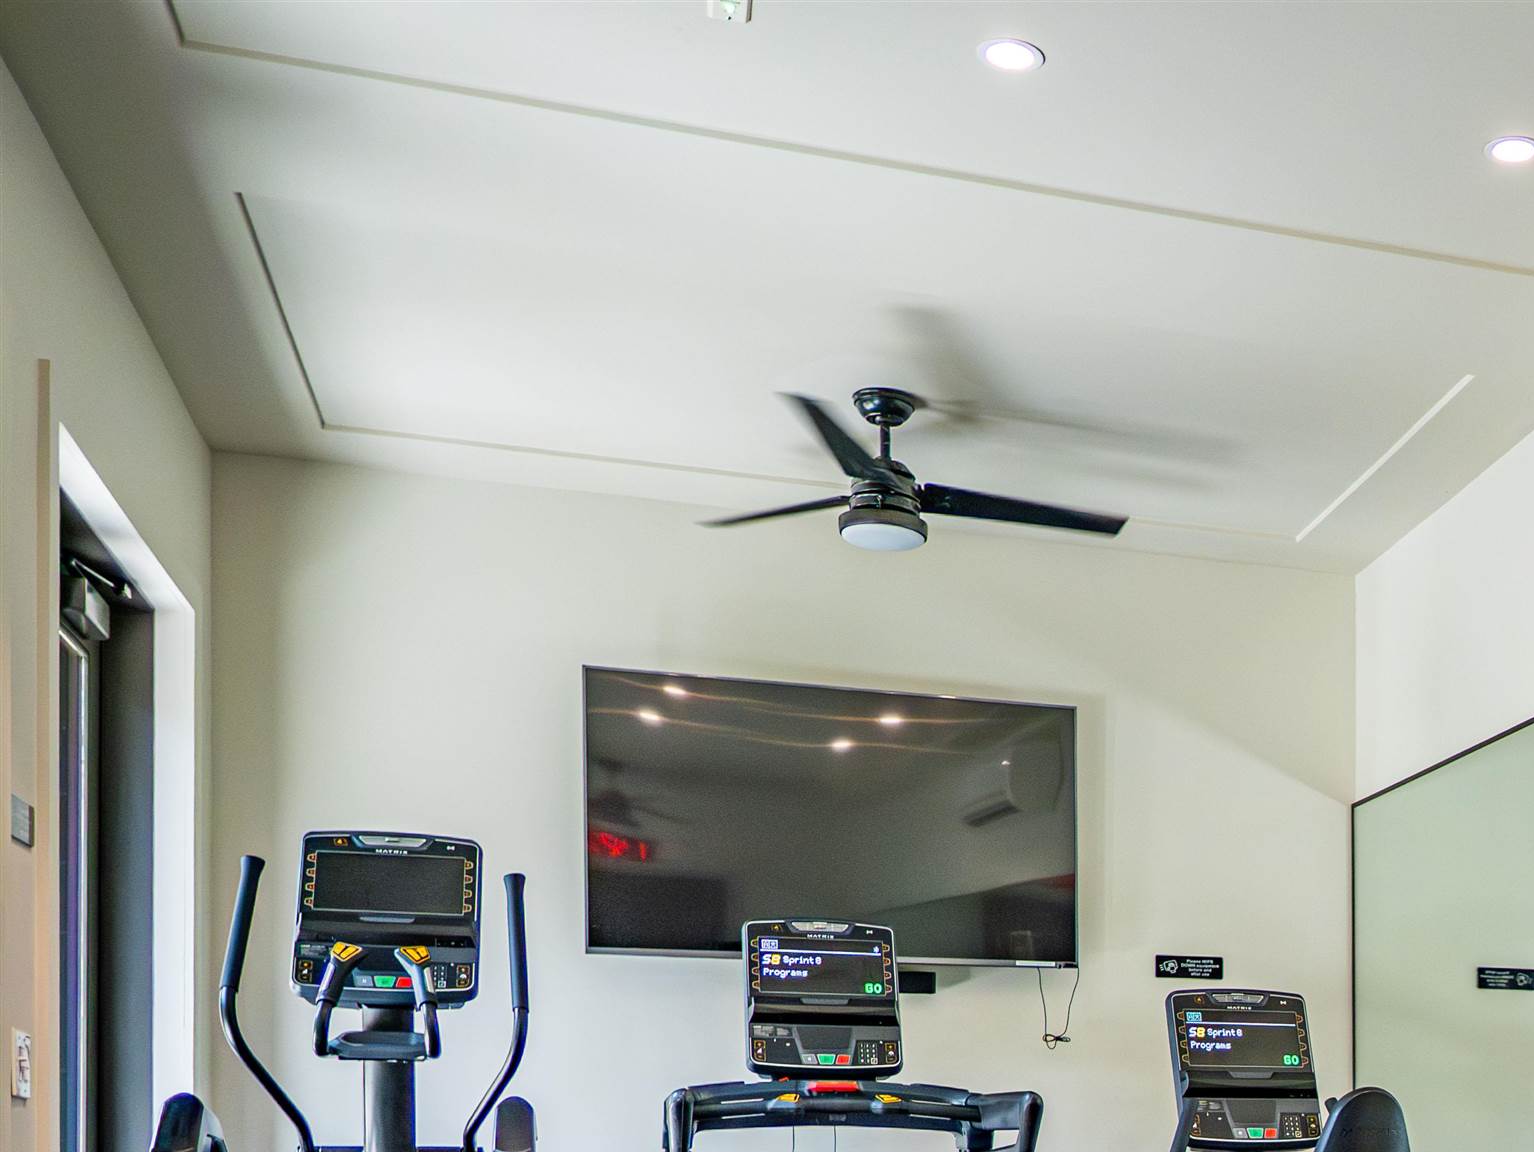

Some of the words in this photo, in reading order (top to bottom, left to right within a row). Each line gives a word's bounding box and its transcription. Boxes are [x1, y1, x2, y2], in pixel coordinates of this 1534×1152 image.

[783, 956, 814, 966] Sprint
[763, 968, 808, 978] Programs
[865, 983, 882, 994] GO
[1207, 1029, 1236, 1039] Sprint
[1190, 1041, 1232, 1052] Programs
[1283, 1055, 1299, 1065] GO
